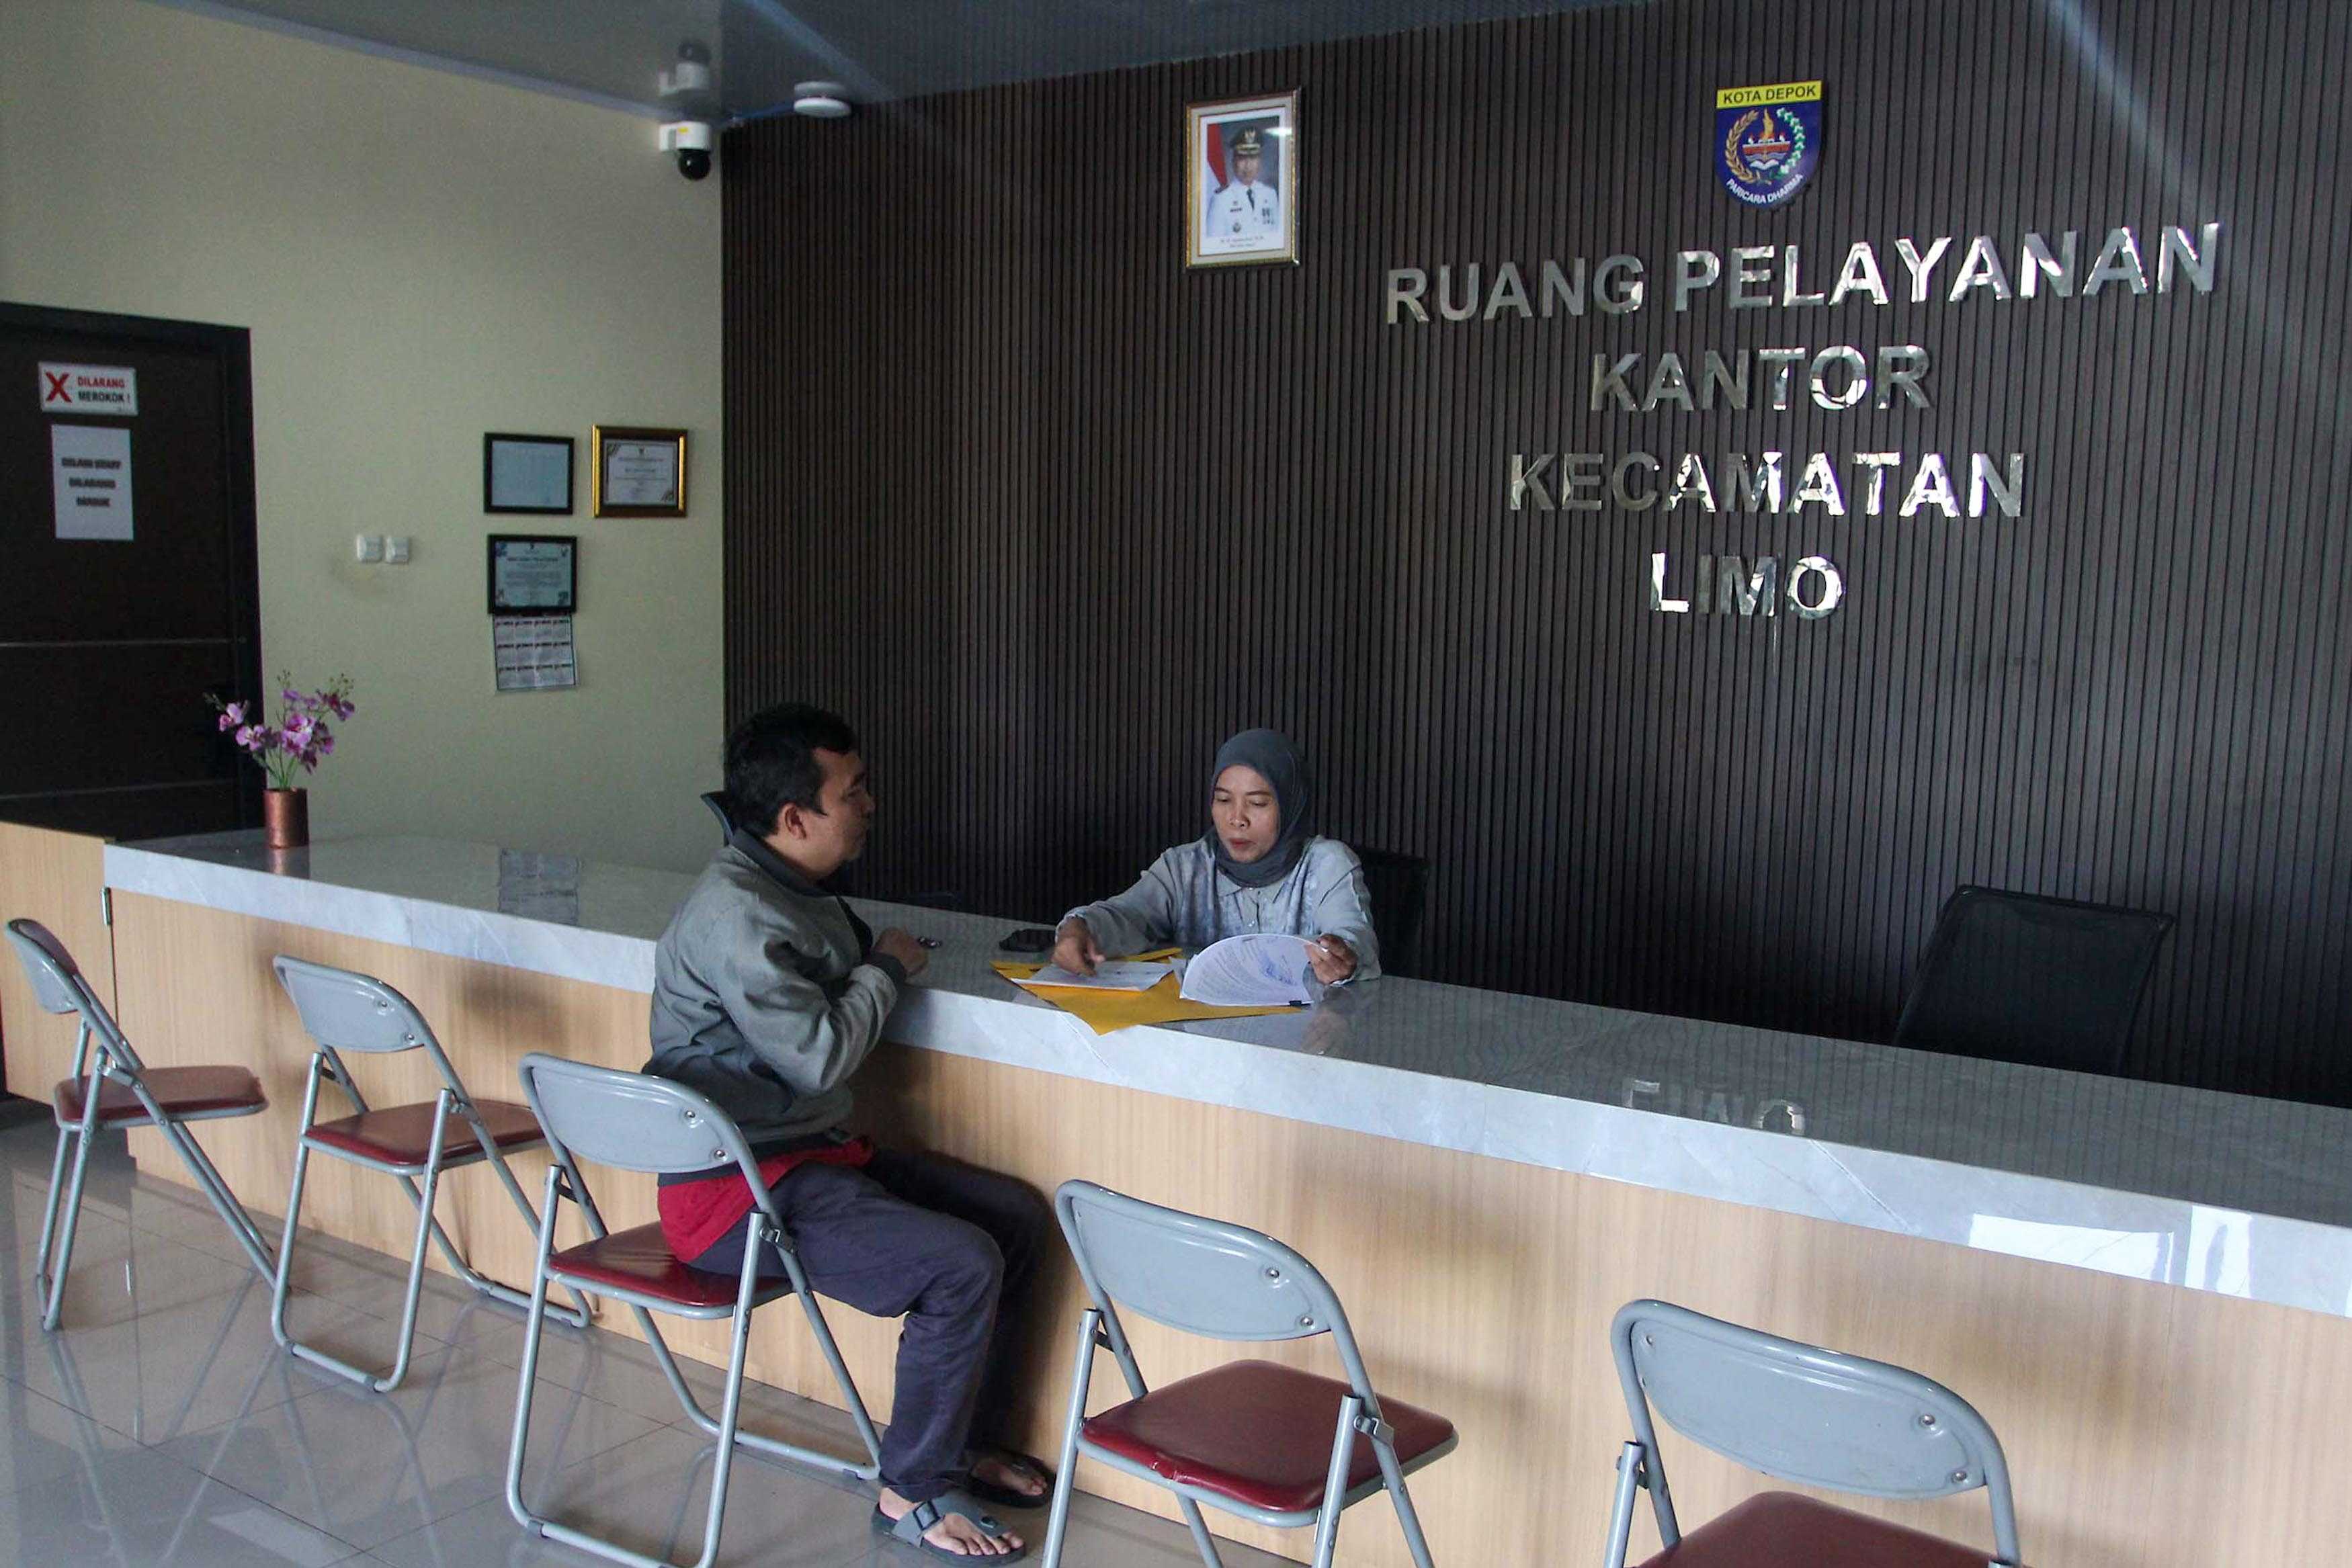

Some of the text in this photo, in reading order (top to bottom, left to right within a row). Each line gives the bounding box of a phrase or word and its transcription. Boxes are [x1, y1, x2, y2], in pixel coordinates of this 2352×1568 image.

[1723, 85, 1816, 104] KOTA DEPOK
[1767, 173, 1804, 202] DHARMA
[1386, 222, 2220, 325] RUANG PELAYANAN
[77, 376, 125, 388] DILARANG
[78, 391, 124, 402] MEROKOK
[1590, 345, 1933, 411] KANTOR
[1509, 451, 2025, 518] KECAMATAN
[1650, 552, 1845, 619] LIMO
